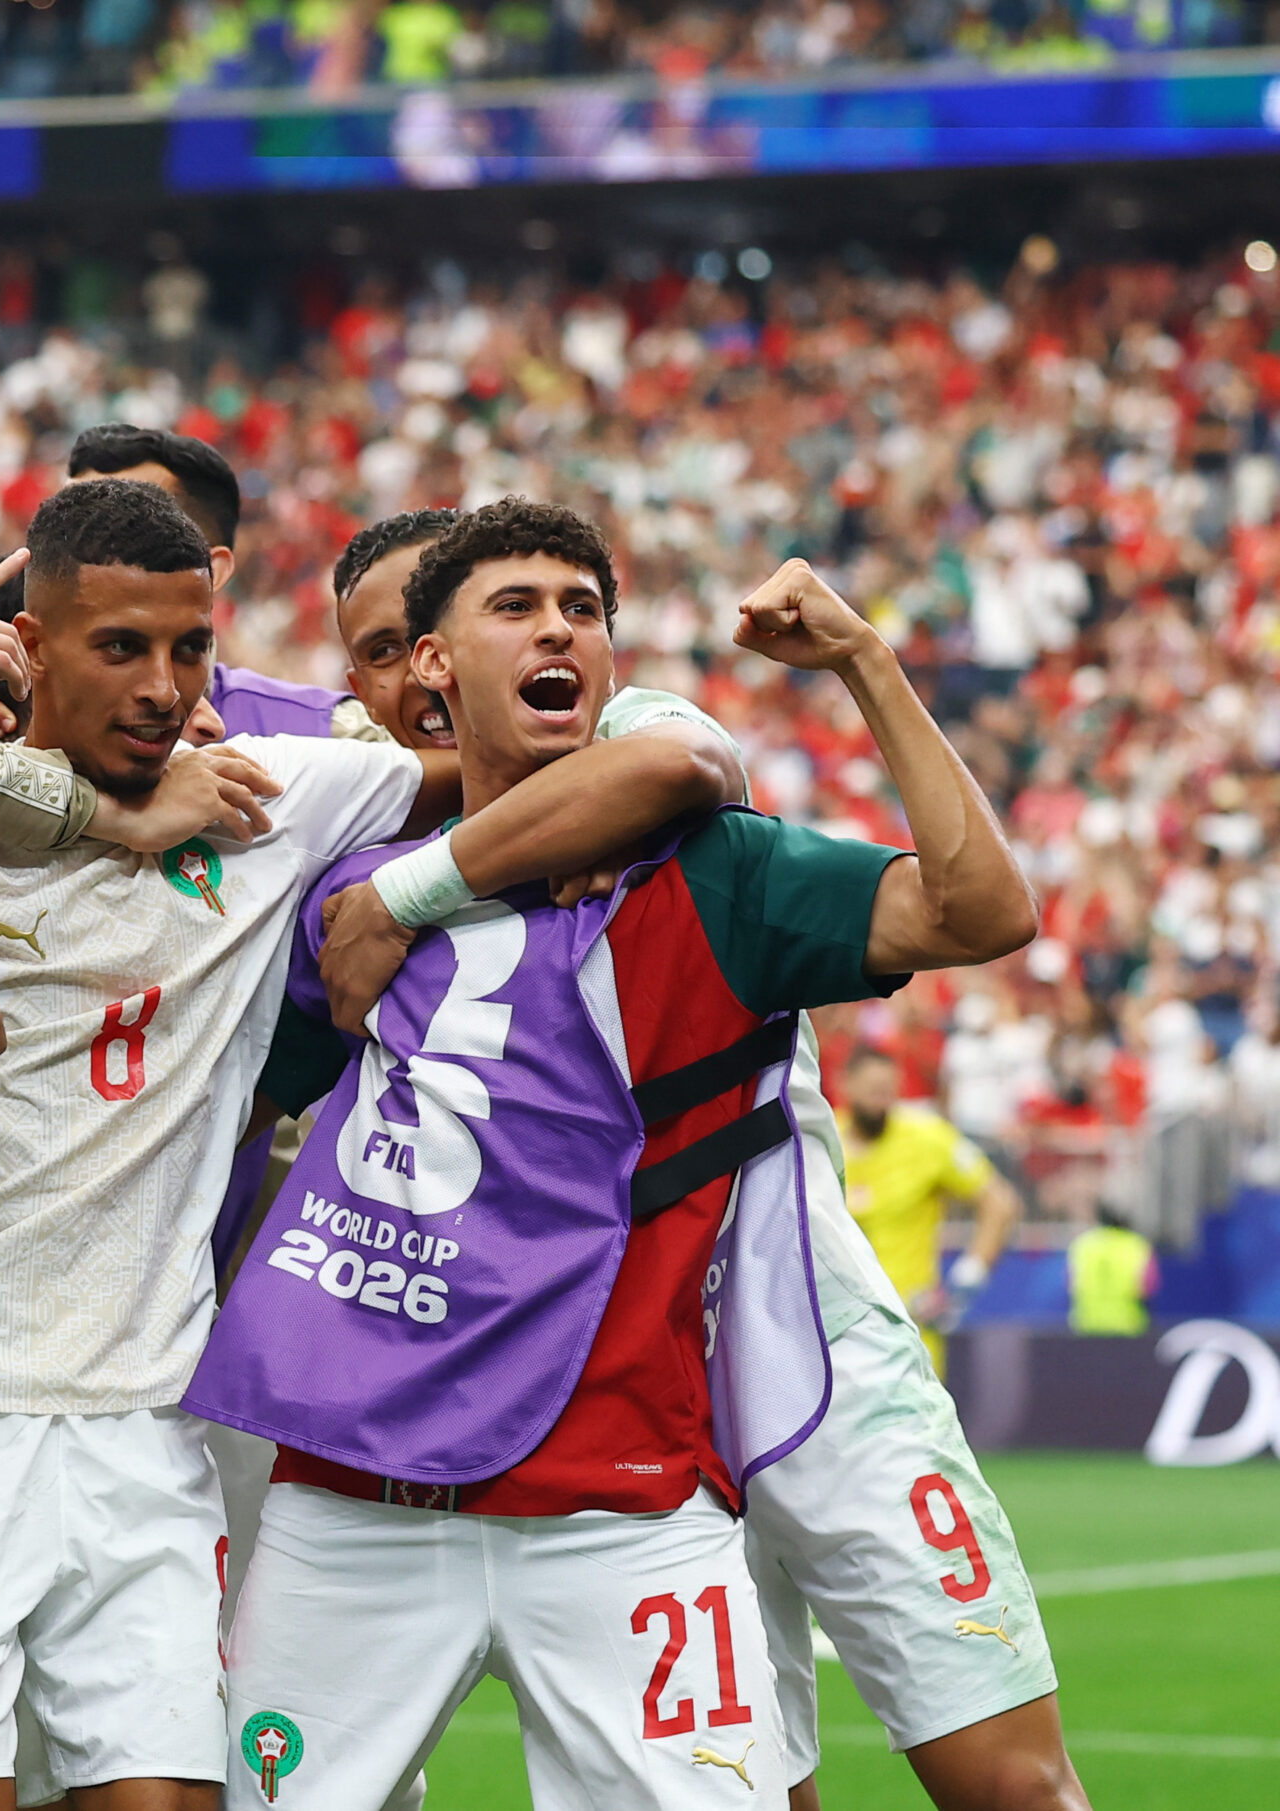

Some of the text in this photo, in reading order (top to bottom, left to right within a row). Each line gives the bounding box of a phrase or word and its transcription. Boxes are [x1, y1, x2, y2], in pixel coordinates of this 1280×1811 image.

[90, 985, 161, 1101] 8
[267, 1229, 449, 1324] 2026
[300, 1190, 460, 1267] WORLD CUP
[1144, 1317, 1280, 1467] D
[909, 1472, 991, 1603] 9
[630, 1585, 752, 1739] 21
